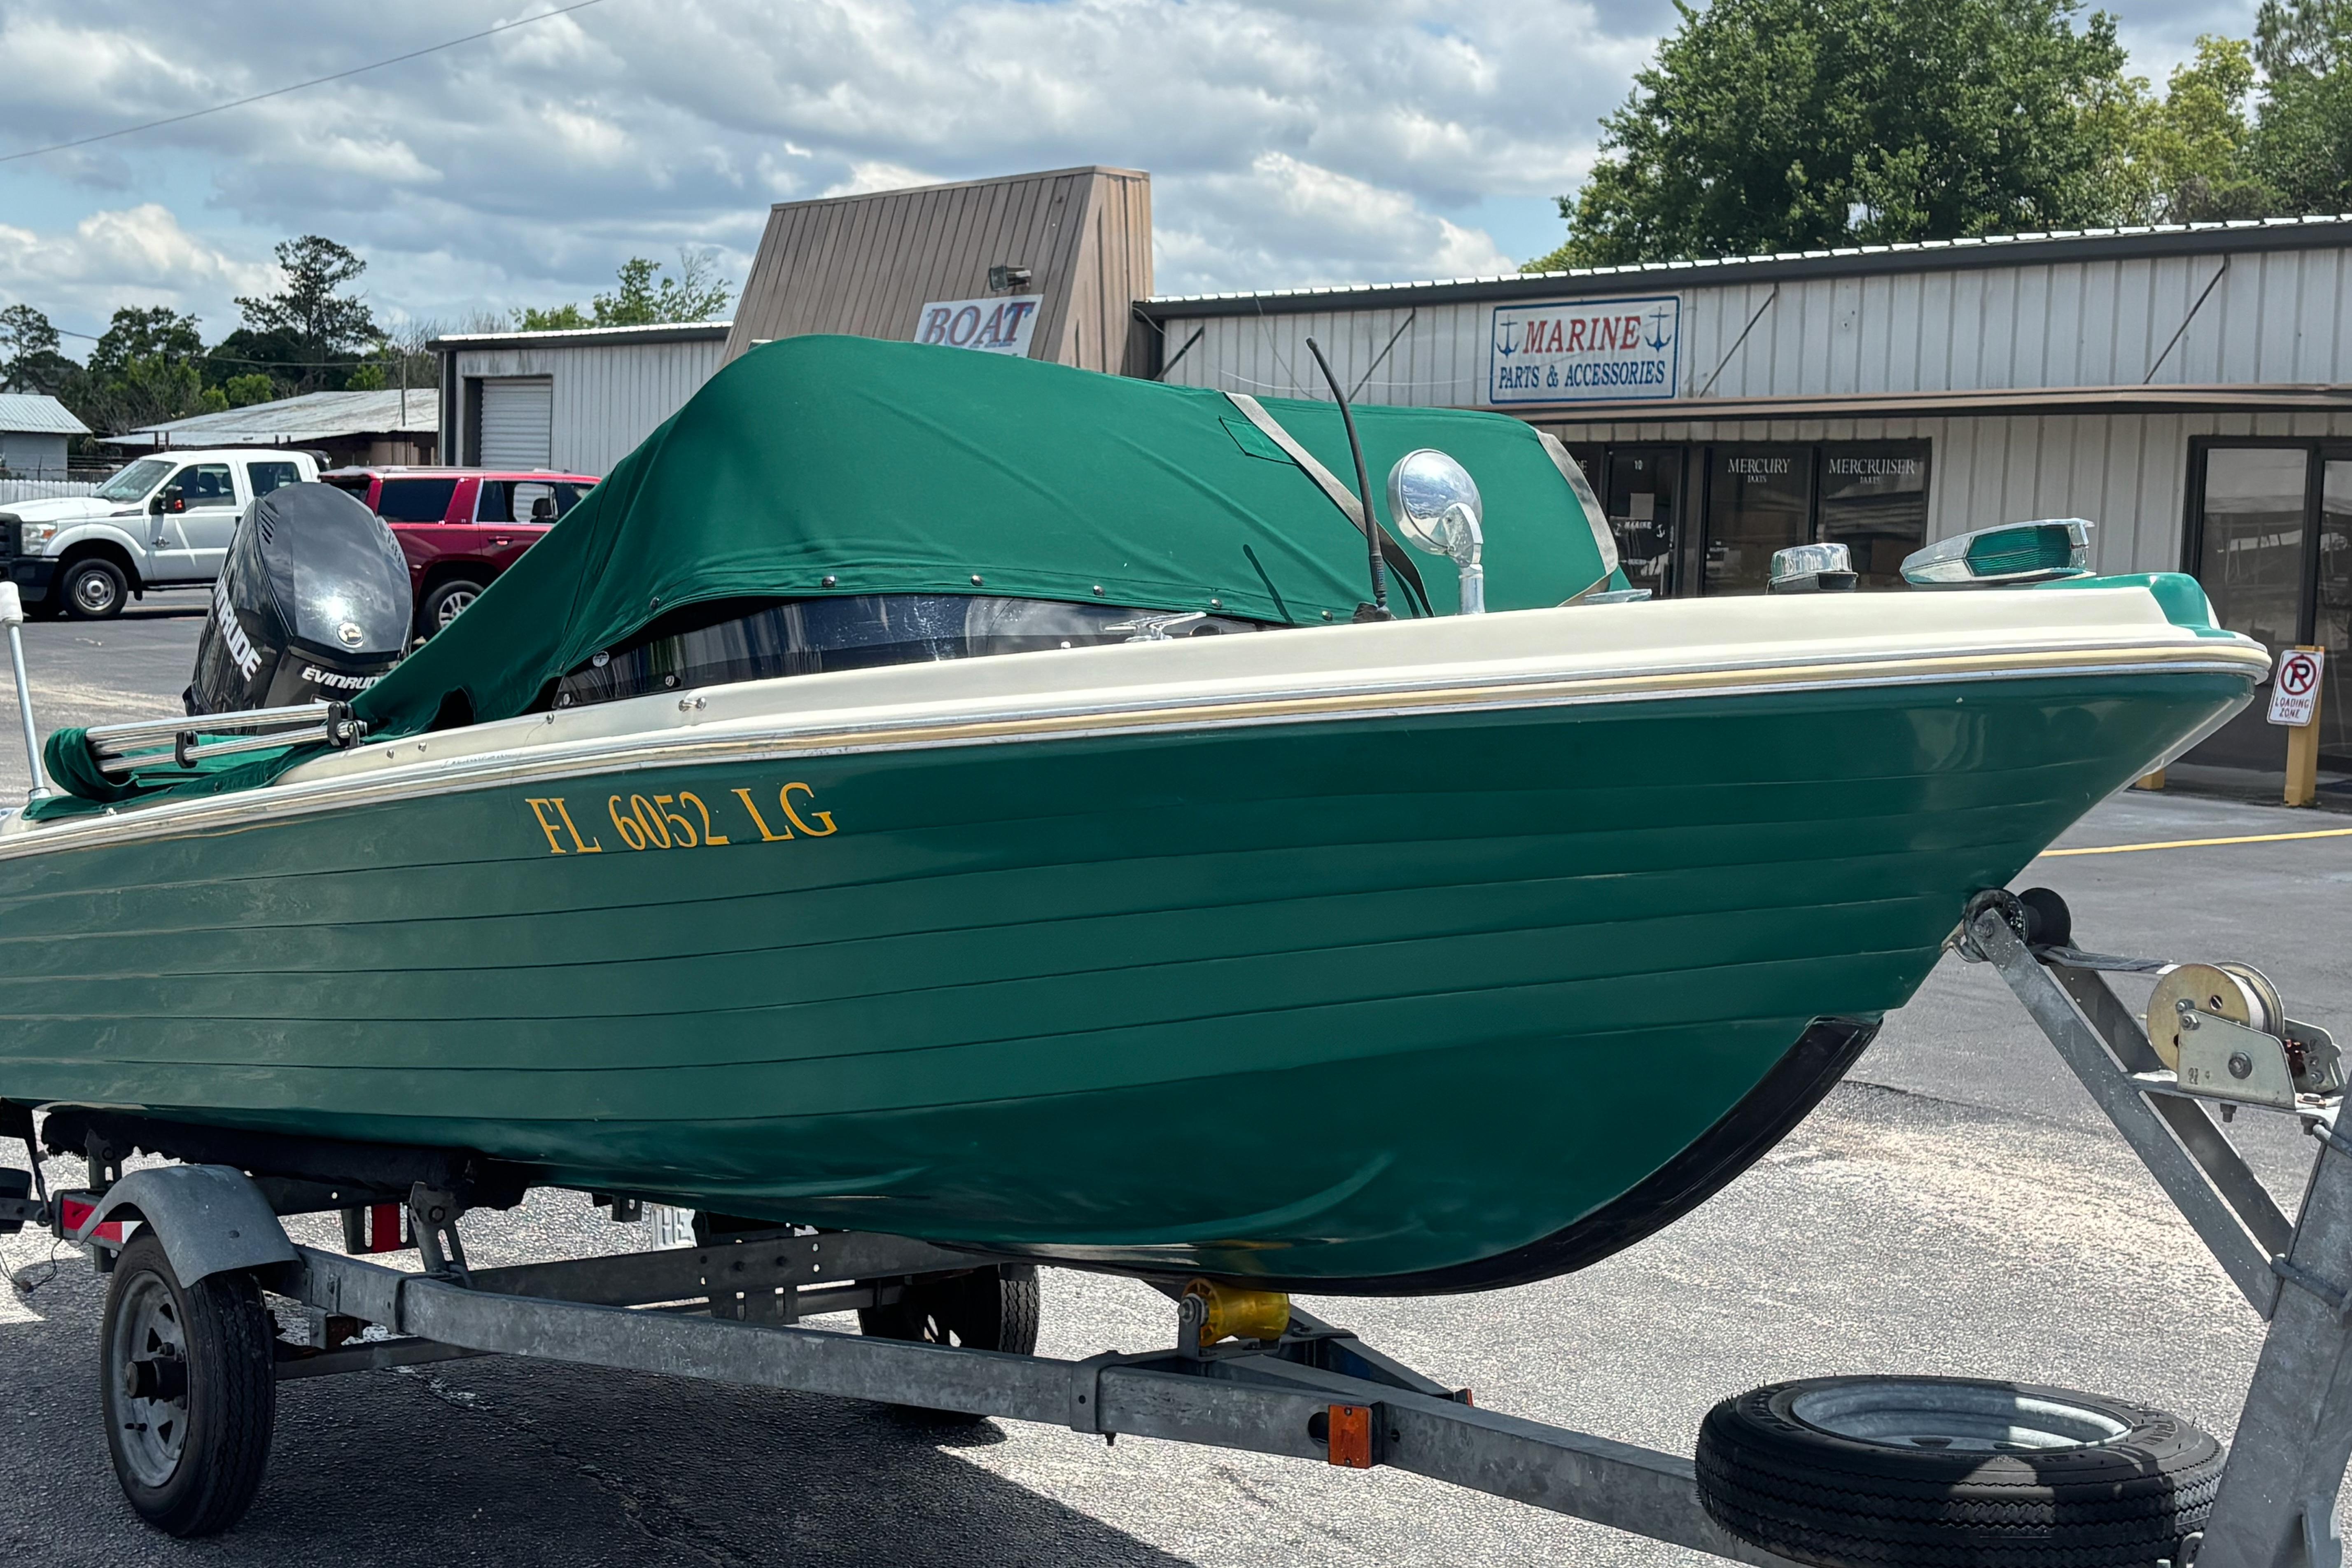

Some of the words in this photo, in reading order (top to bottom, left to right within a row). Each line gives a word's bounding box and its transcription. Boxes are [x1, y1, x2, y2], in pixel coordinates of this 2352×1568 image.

[923, 301, 1036, 348] BOAT
[1523, 316, 1641, 353] MARINE
[1499, 365, 1540, 389] PARTS
[1546, 365, 1559, 388] &
[1565, 360, 1666, 387] ACCESSORIES
[1727, 458, 1790, 474] MERCURY
[1829, 458, 1914, 474] MERCRUISER
[302, 667, 384, 689] EVINRUD
[2275, 697, 2310, 709] LOADING
[2279, 708, 2300, 719] ZONE
[525, 798, 602, 854] FL
[609, 791, 729, 851] 6052
[731, 782, 838, 842] LG
